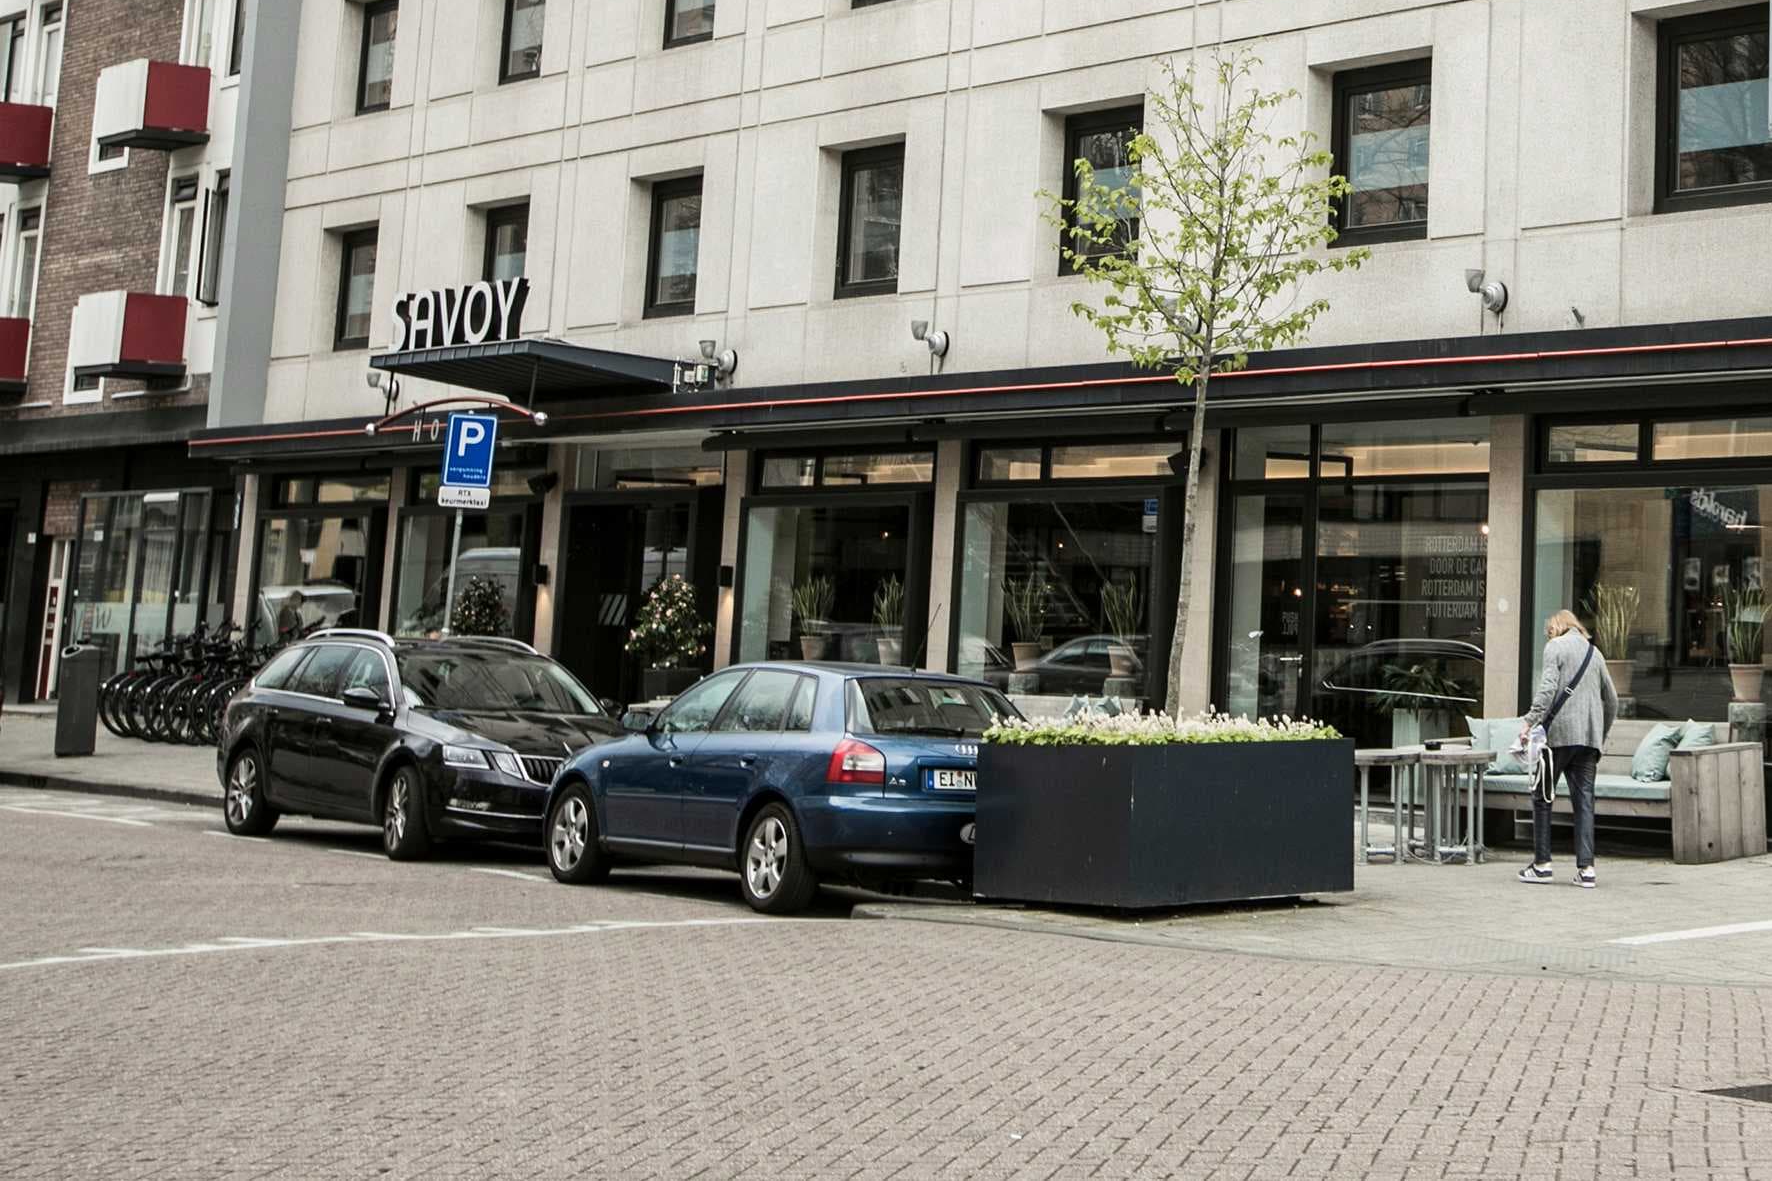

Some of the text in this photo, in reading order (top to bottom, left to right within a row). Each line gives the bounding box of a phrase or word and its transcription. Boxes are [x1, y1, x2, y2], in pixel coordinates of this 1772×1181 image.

[388, 276, 526, 354] SAVOY
[458, 421, 485, 456] P
[1425, 535, 1478, 552] ROTTERDAM
[1430, 558, 1454, 574] DOOR
[1456, 558, 1468, 574] DE
[1421, 579, 1486, 596] ROTTERDAM IS
[1425, 601, 1478, 618] ROTTERDAM
